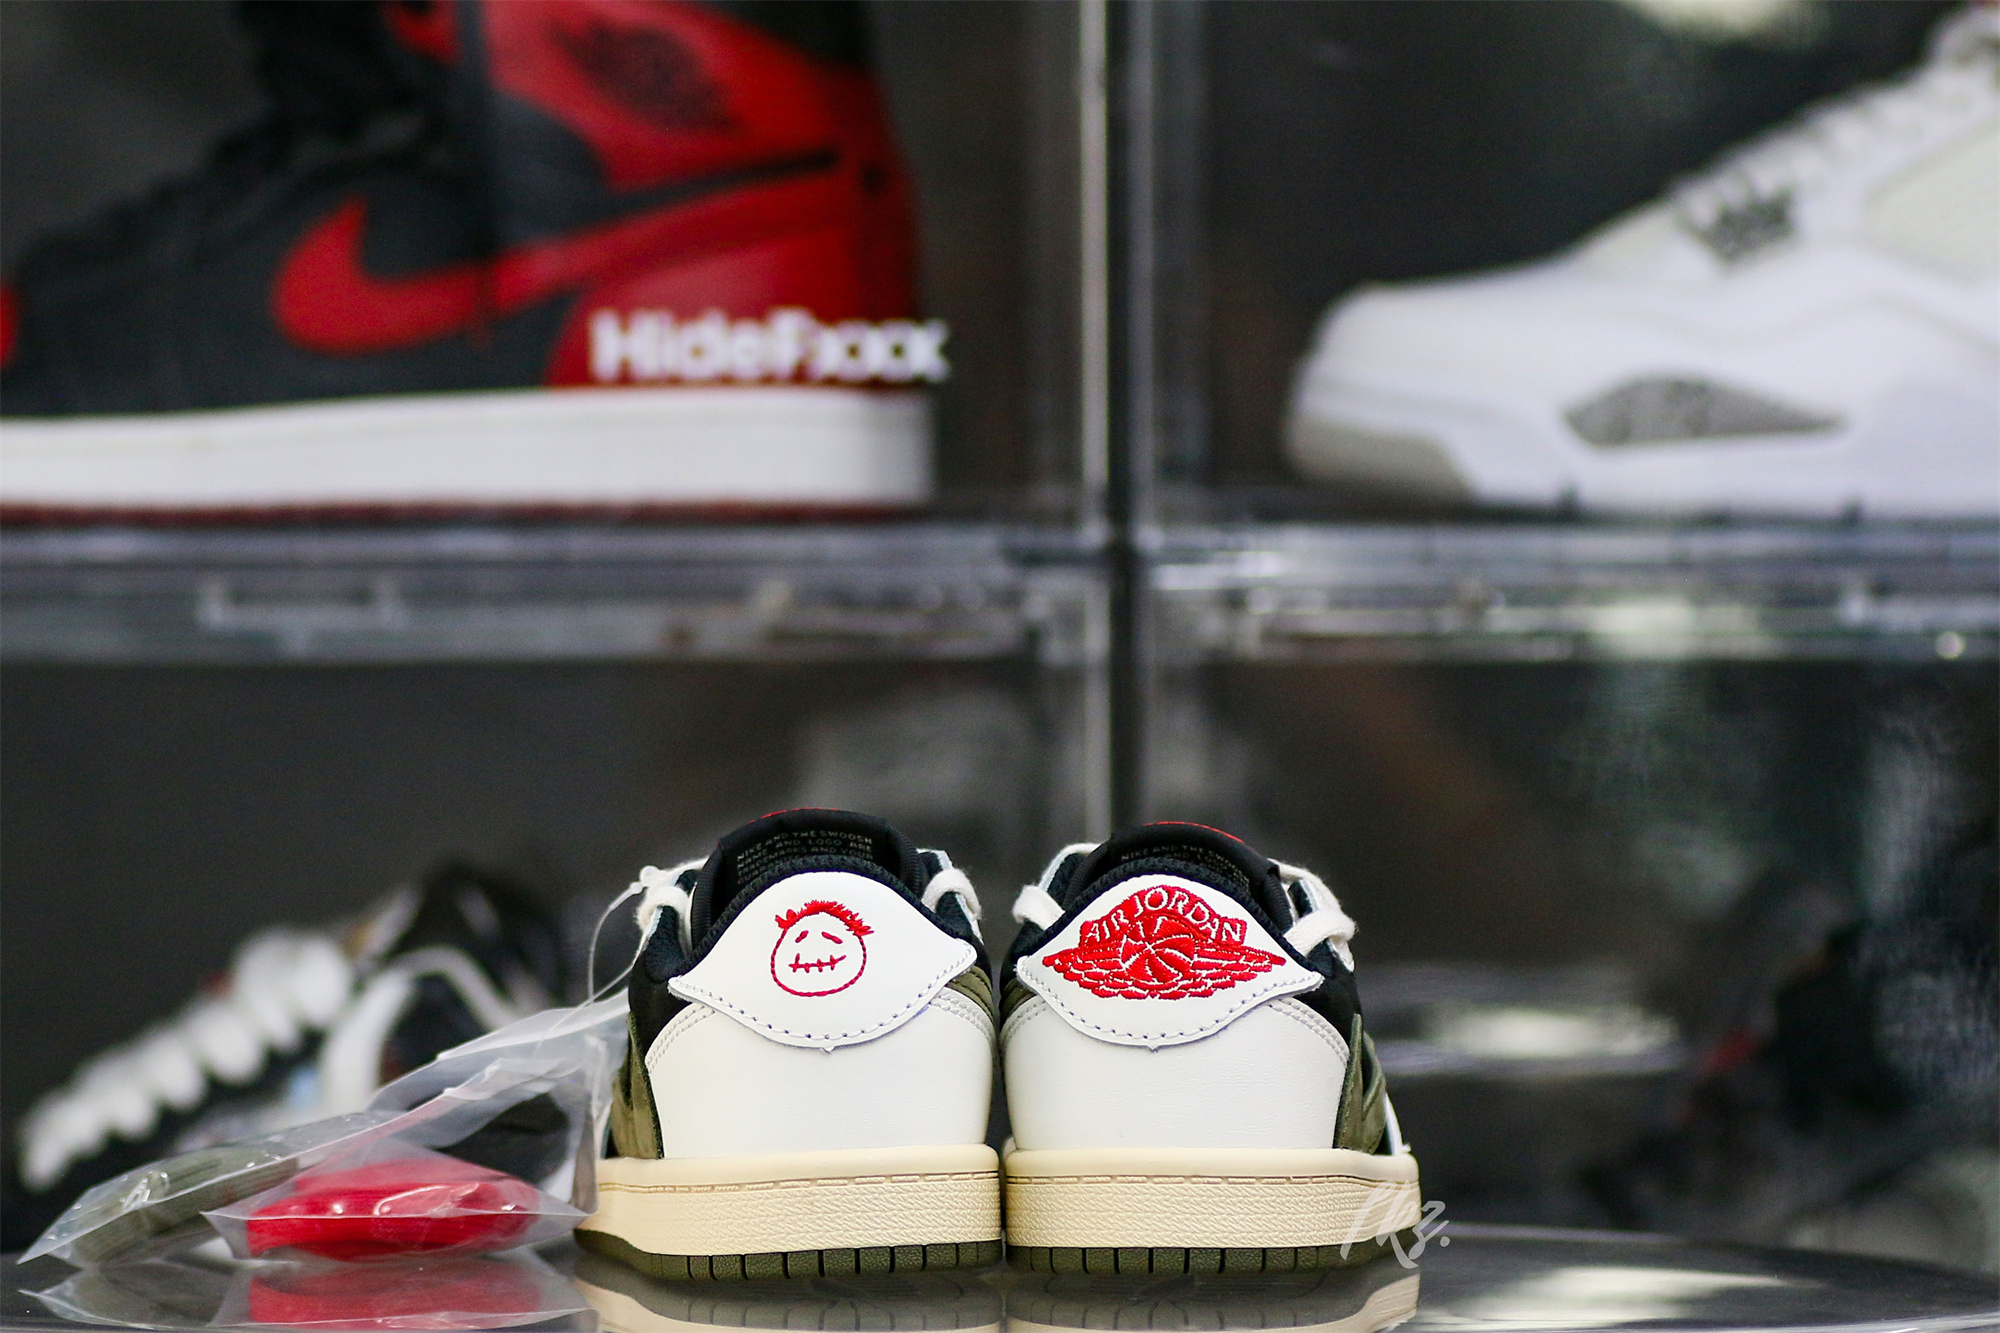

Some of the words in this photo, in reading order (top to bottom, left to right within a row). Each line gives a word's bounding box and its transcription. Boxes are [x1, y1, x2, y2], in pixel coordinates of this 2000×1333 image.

[737, 842, 763, 861] NIKE
[765, 833, 789, 846] AND
[792, 830, 817, 838] THE
[820, 830, 873, 844] SWOOSH
[737, 849, 768, 869] NAME
[775, 840, 801, 848] AND
[808, 838, 842, 846] LOGO
[849, 842, 873, 853] ARE
[810, 846, 837, 854] AND
[1121, 848, 1149, 862] NIKE
[1152, 845, 1178, 853] AND
[1182, 845, 1204, 854] THE
[1085, 909, 1130, 944] AIR
[1134, 887, 1241, 942] JORDAN
